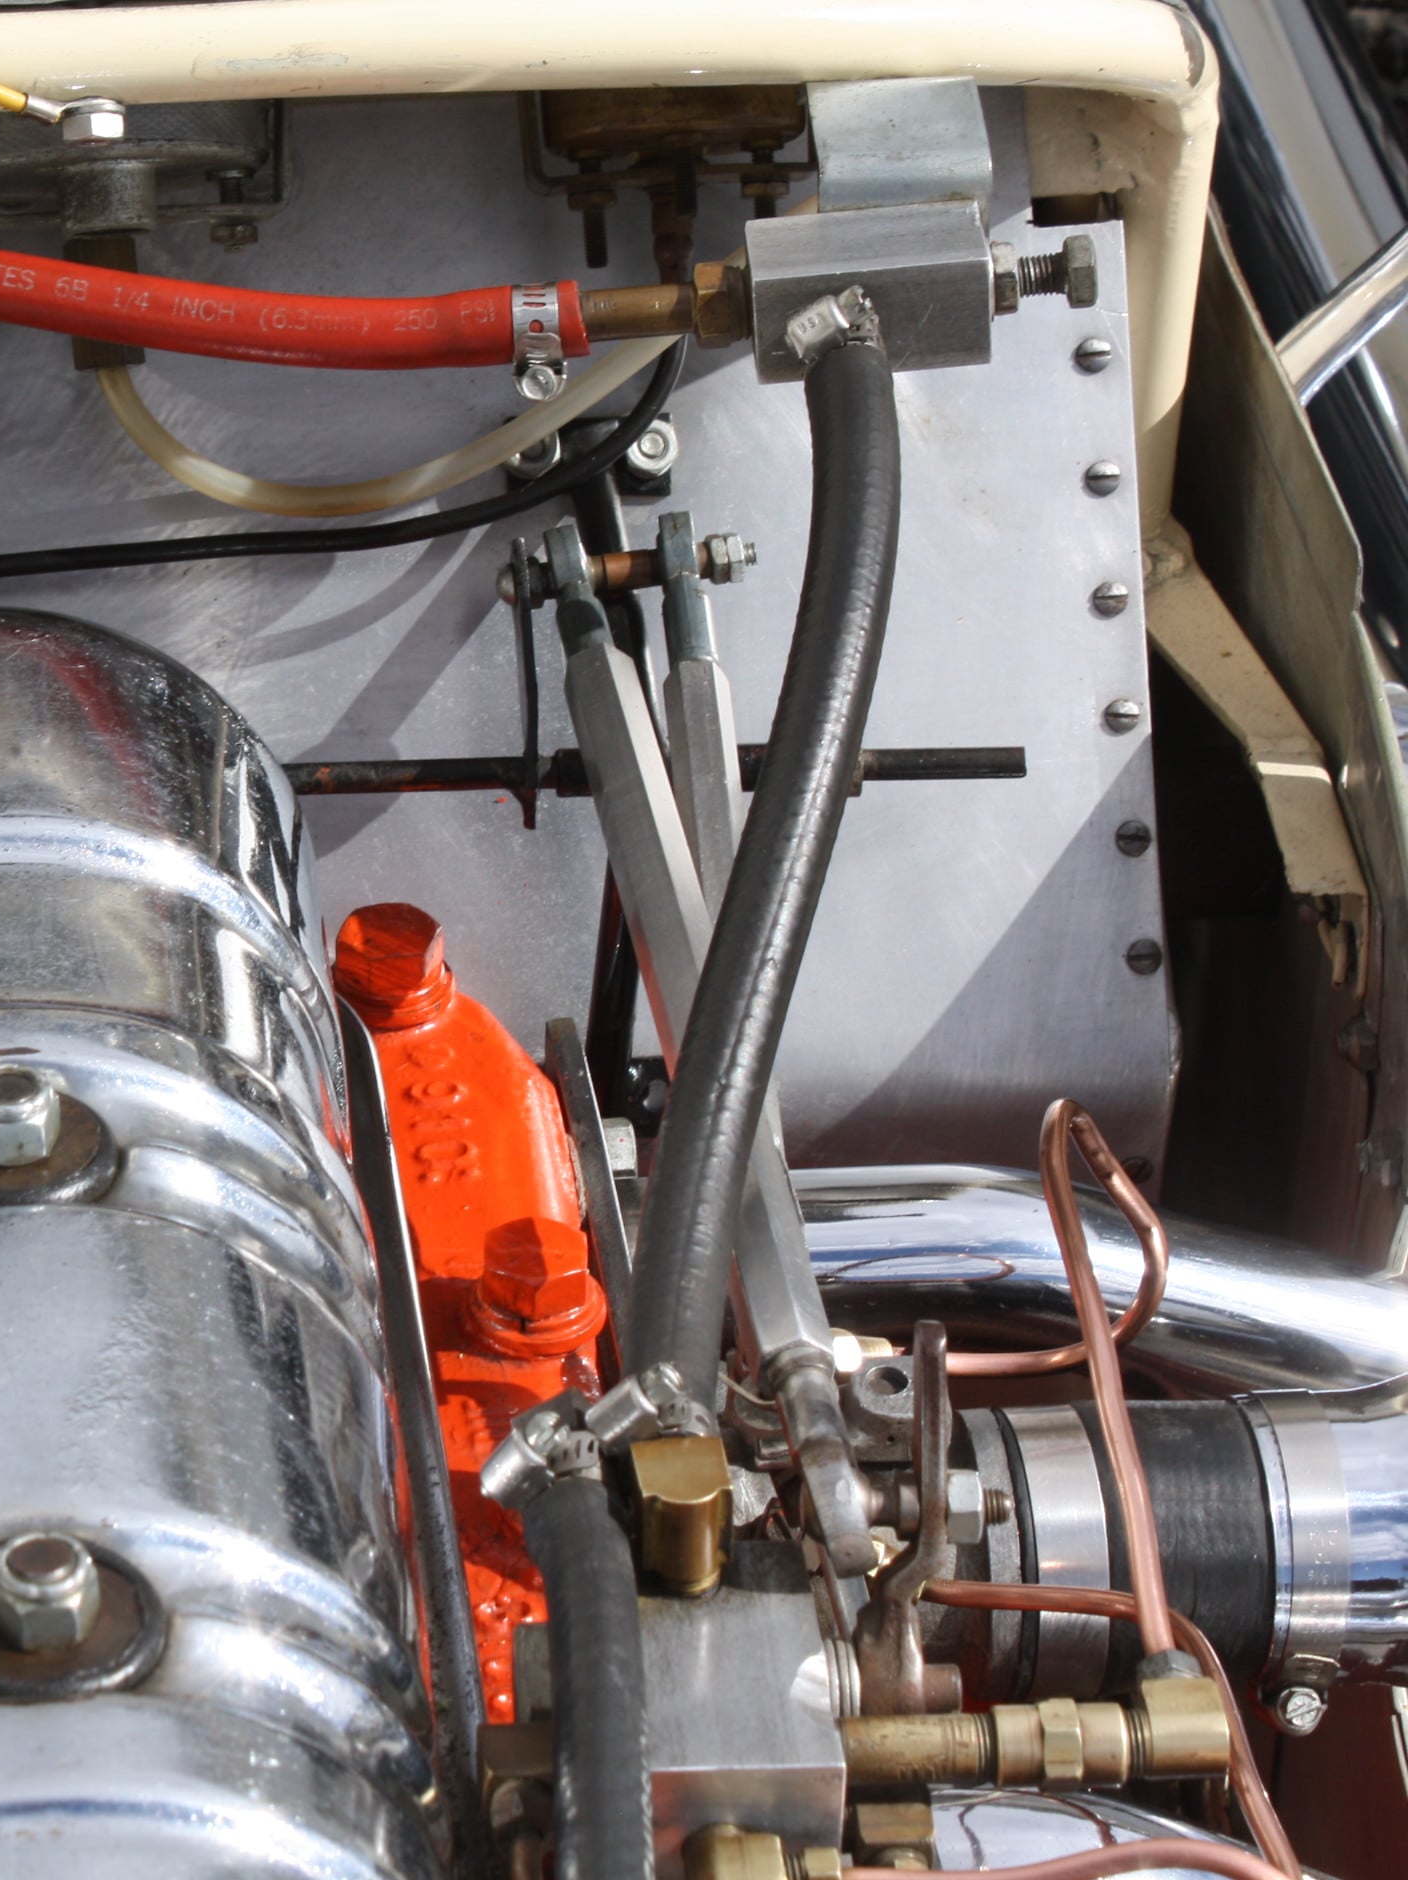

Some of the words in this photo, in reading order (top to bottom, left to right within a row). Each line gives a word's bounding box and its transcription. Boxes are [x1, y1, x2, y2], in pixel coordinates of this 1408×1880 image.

[54, 276, 90, 302] 6B
[112, 285, 151, 313] 1/4
[171, 296, 237, 323] INCH
[393, 306, 439, 331] 250
[460, 298, 497, 325] PSI
